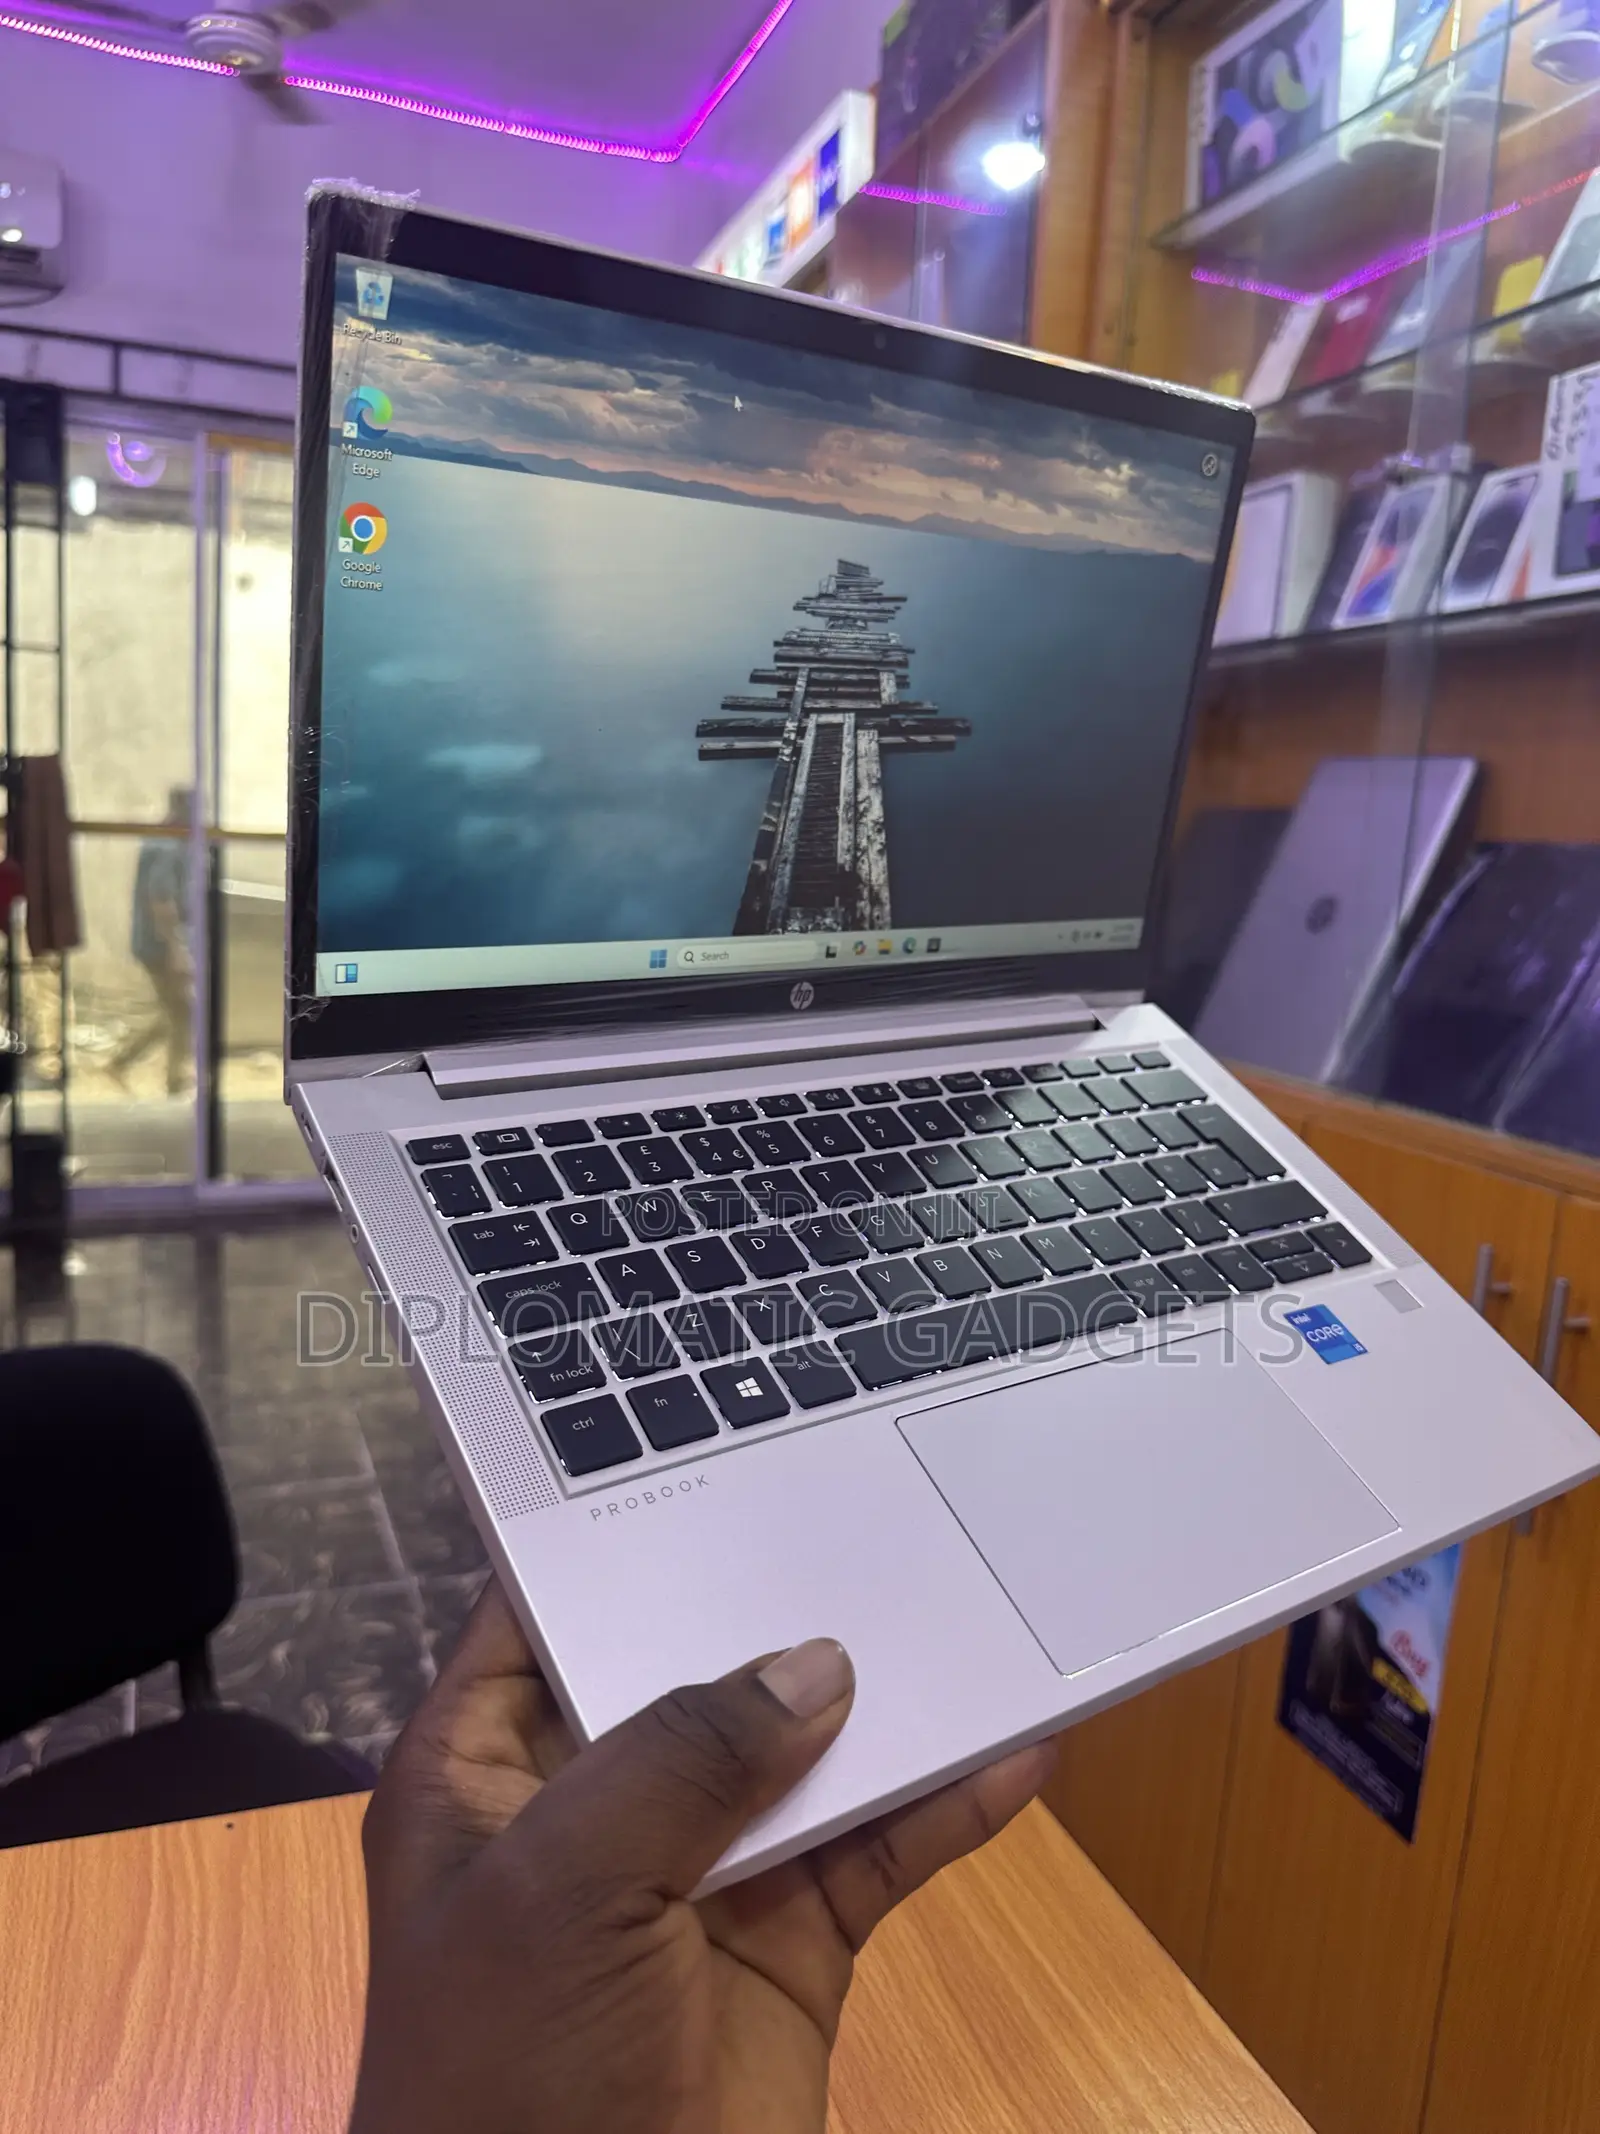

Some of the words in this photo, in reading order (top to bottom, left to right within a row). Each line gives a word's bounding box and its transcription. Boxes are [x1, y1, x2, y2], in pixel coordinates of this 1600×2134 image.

[384, 330, 403, 345] Bin
[340, 443, 393, 461] Microsoft
[352, 463, 380, 479] Edge
[342, 558, 381, 575] Google
[340, 576, 383, 591] Chrome
[700, 950, 730, 962] Search
[790, 981, 815, 1010] hp
[925, 1120, 938, 1131] 8
[975, 1114, 987, 1125] 9
[874, 1128, 885, 1139] 7
[431, 1141, 453, 1151] esc
[823, 1135, 835, 1146] 6
[768, 1143, 780, 1154] 5
[711, 1152, 722, 1162] 4
[924, 1154, 939, 1165] U
[648, 1161, 661, 1172] 3
[872, 1162, 885, 1173] Y
[583, 1171, 597, 1183] 2
[818, 1170, 831, 1182] T
[761, 1180, 776, 1191] R
[701, 1191, 716, 1203] E
[1024, 1187, 1039, 1199] K
[637, 1199, 658, 1213] W
[923, 1205, 938, 1216] H
[570, 1212, 588, 1225] Q
[870, 1214, 885, 1226] G
[473, 1229, 495, 1241] tab
[811, 1225, 823, 1238] F
[751, 1238, 766, 1250] D
[1038, 1237, 1055, 1249] M
[687, 1250, 702, 1263] S
[986, 1248, 1003, 1260] N
[622, 1263, 637, 1277] A
[933, 1259, 948, 1272] B
[876, 1270, 891, 1283] V
[505, 1284, 534, 1300] caps
[535, 1279, 562, 1293] lock
[818, 1283, 834, 1297] C
[753, 1297, 771, 1312] X
[685, 1312, 704, 1328] Z
[797, 1359, 813, 1371] alt
[549, 1371, 565, 1383] fn
[566, 1364, 594, 1379] lock
[653, 1396, 669, 1408] fn
[571, 1416, 595, 1431] ctrl
[590, 1474, 710, 1522] PROBOOK
